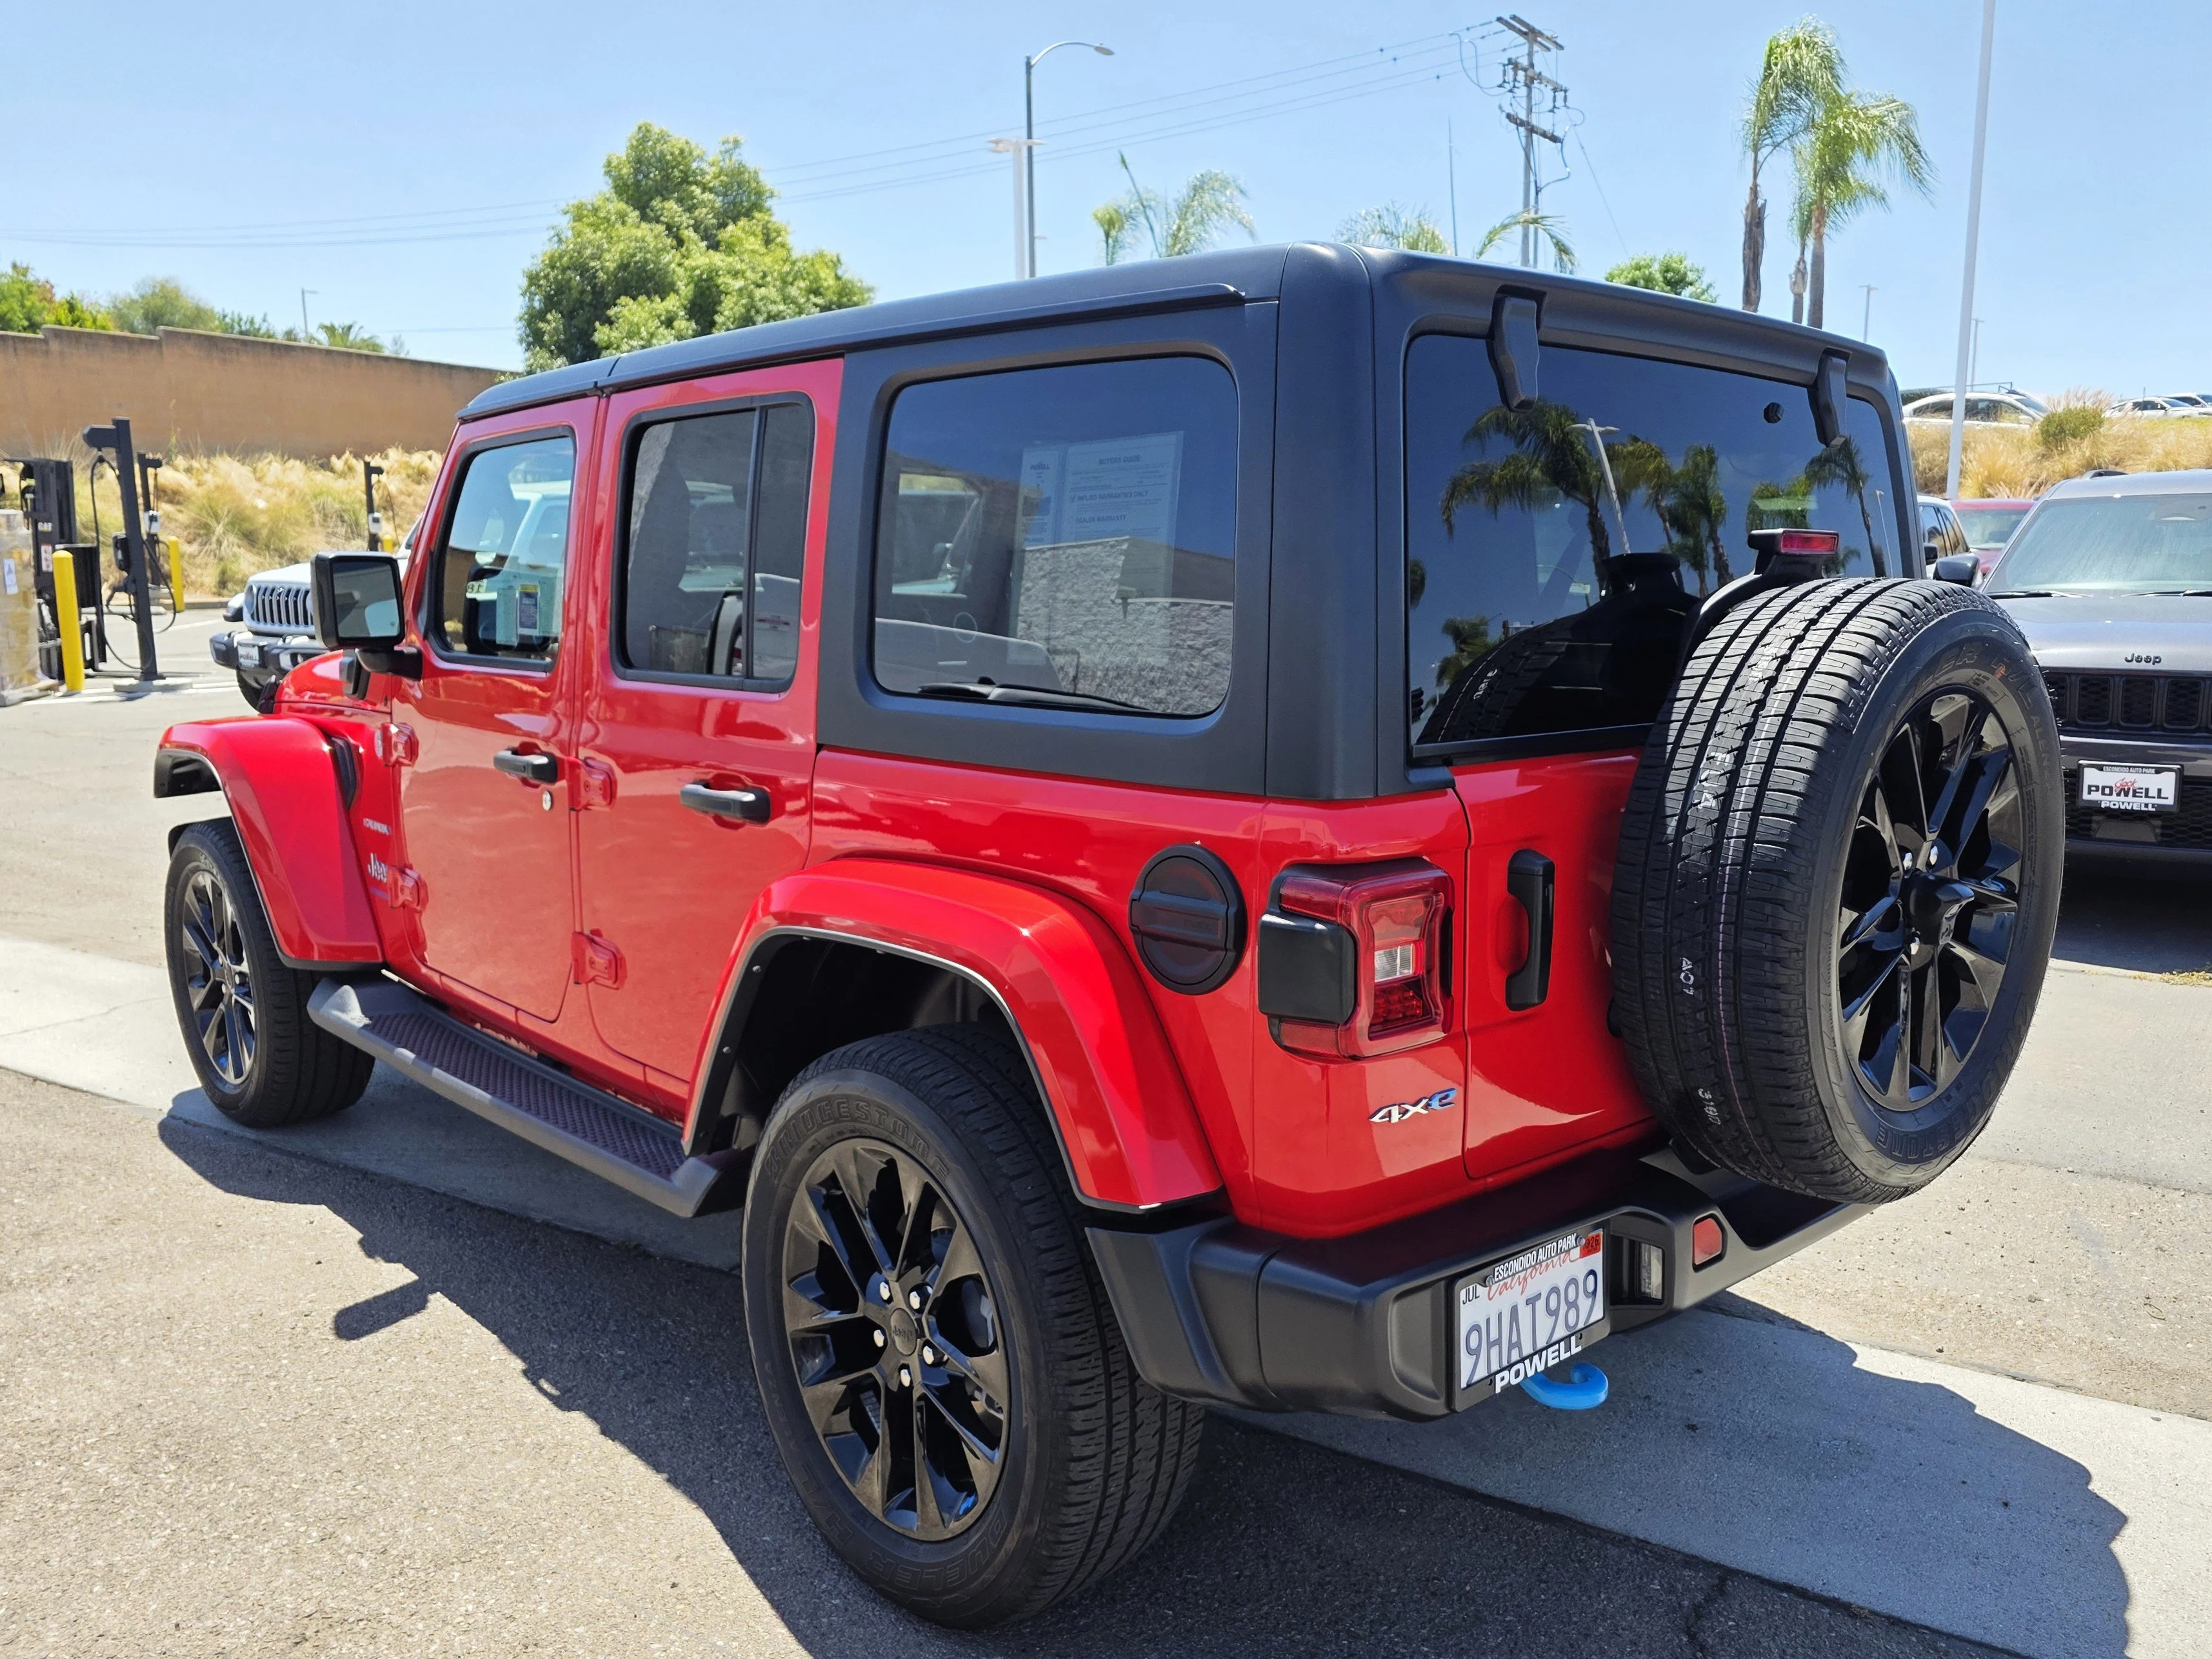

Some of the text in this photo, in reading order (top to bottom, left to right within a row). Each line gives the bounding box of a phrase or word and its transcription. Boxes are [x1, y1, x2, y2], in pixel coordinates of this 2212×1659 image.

[2124, 652, 2162, 665] Jeep
[2087, 784, 2169, 799] POWELL
[2115, 777, 2140, 793] Jack
[2100, 800, 2157, 812] POWELL
[1494, 1233, 1577, 1280] ESCONDIDO AUTO PARK
[1462, 1283, 1480, 1305] JUL
[1465, 1269, 1598, 1386] 9HAT989
[1495, 1334, 1582, 1394] POWELL
